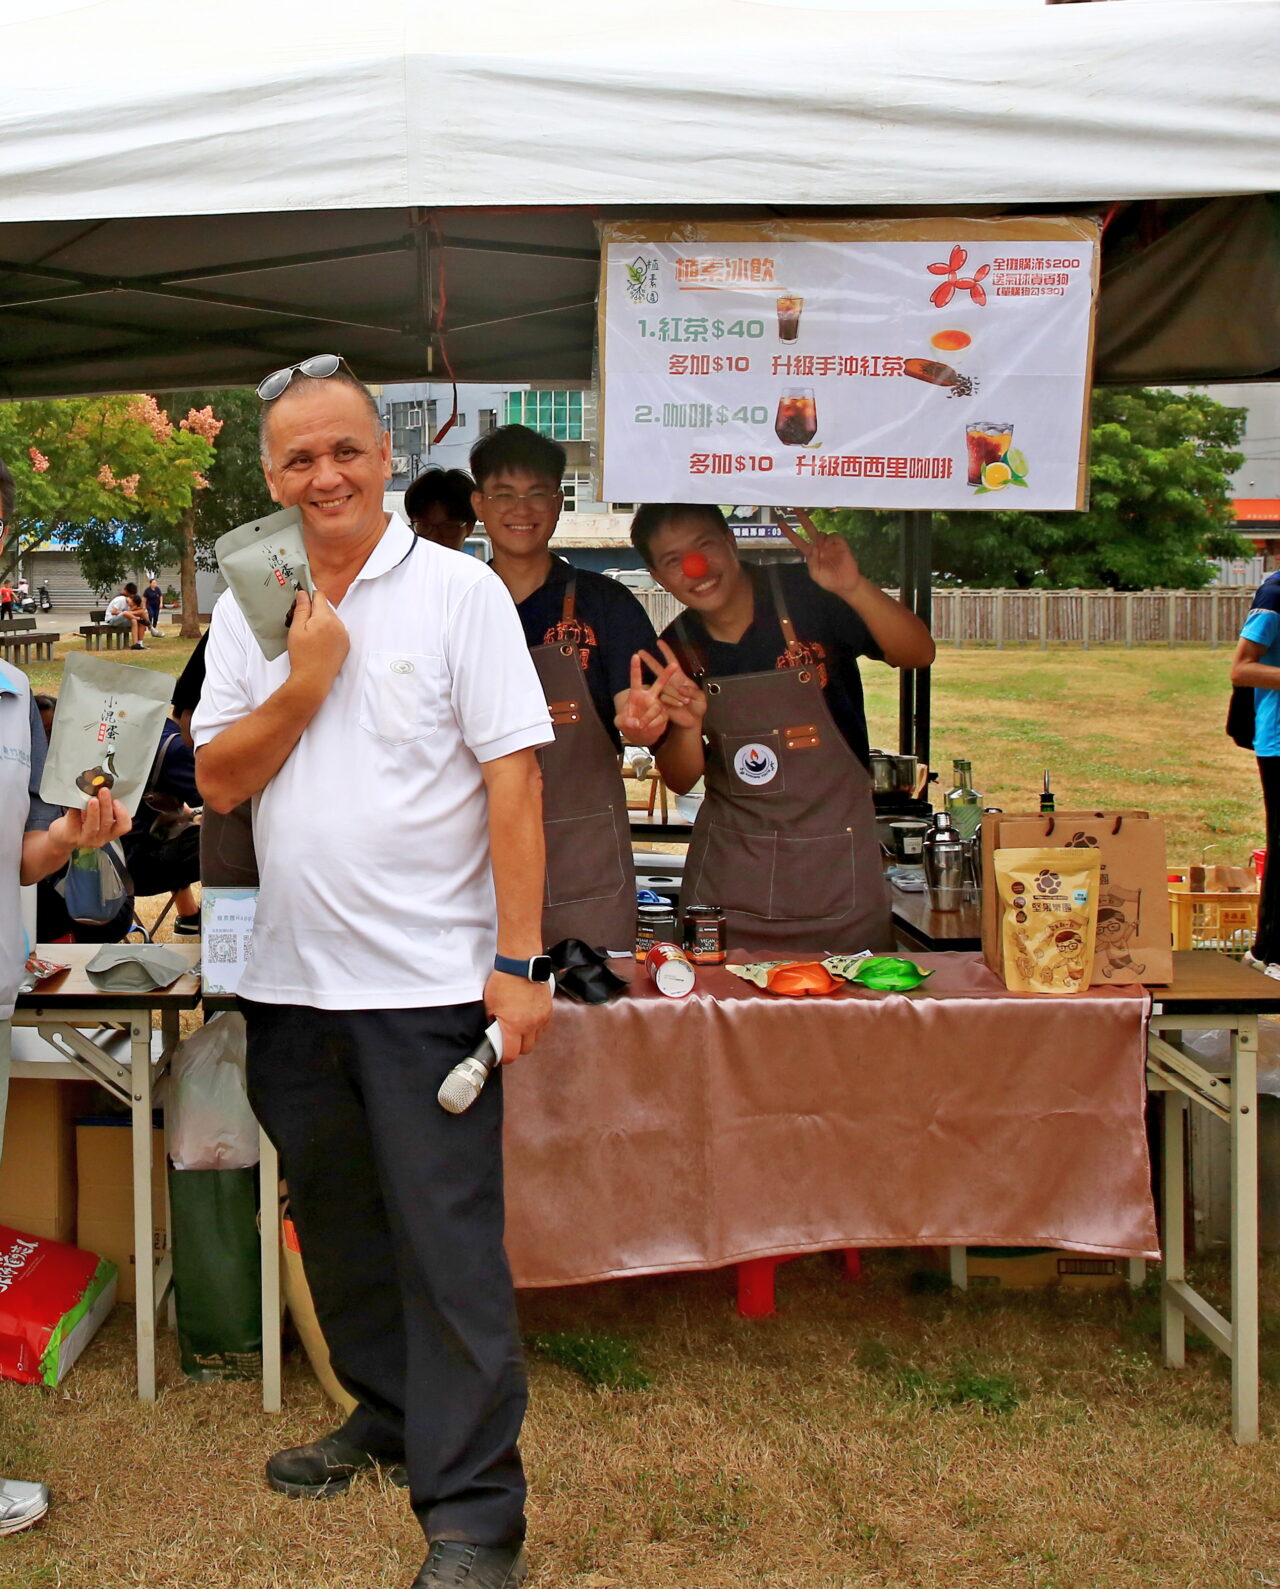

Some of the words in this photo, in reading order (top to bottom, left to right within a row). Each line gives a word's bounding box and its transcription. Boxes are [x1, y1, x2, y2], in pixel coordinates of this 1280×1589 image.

[675, 257, 775, 282] 植素冰飲
[638, 316, 765, 343] 1.紅茶$40
[668, 354, 750, 375] 多加$10
[771, 354, 905, 377] 升級手沖紅茶
[634, 402, 769, 428] 2.咖啡$40
[689, 452, 774, 475] 多加$10
[795, 453, 954, 480] 升級西西里咖啡
